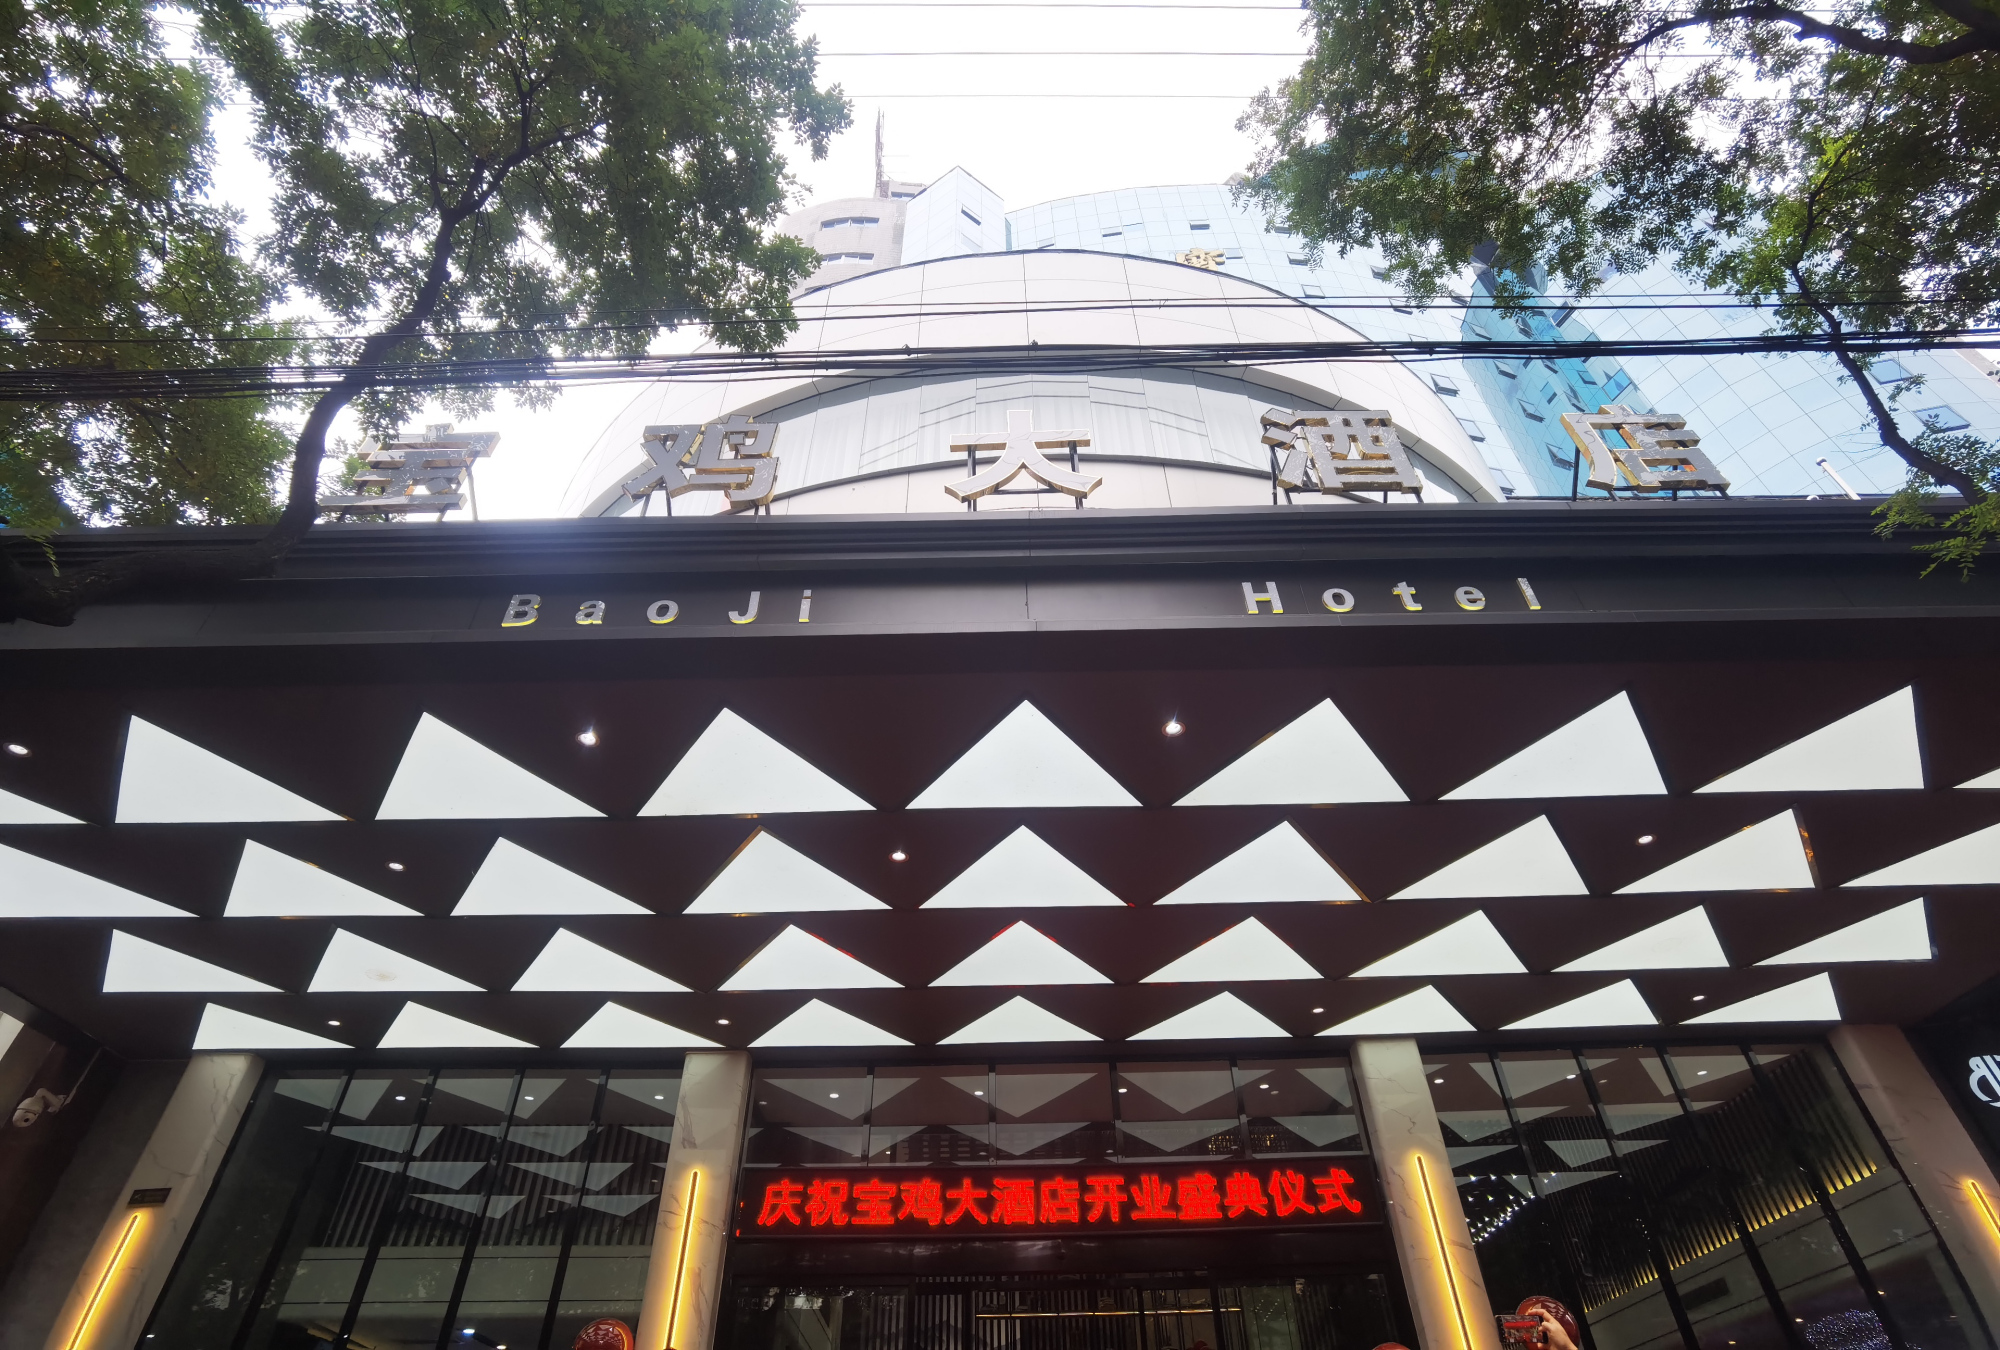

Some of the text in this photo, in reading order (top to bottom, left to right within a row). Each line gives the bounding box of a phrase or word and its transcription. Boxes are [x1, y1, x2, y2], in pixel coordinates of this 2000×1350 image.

[319, 403, 1731, 514] 宝鸡大酒店
[501, 576, 1542, 628] BaoJi Hotel
[757, 1168, 1362, 1227] 庆祝宝鸡大酒店开业盛典仪式
